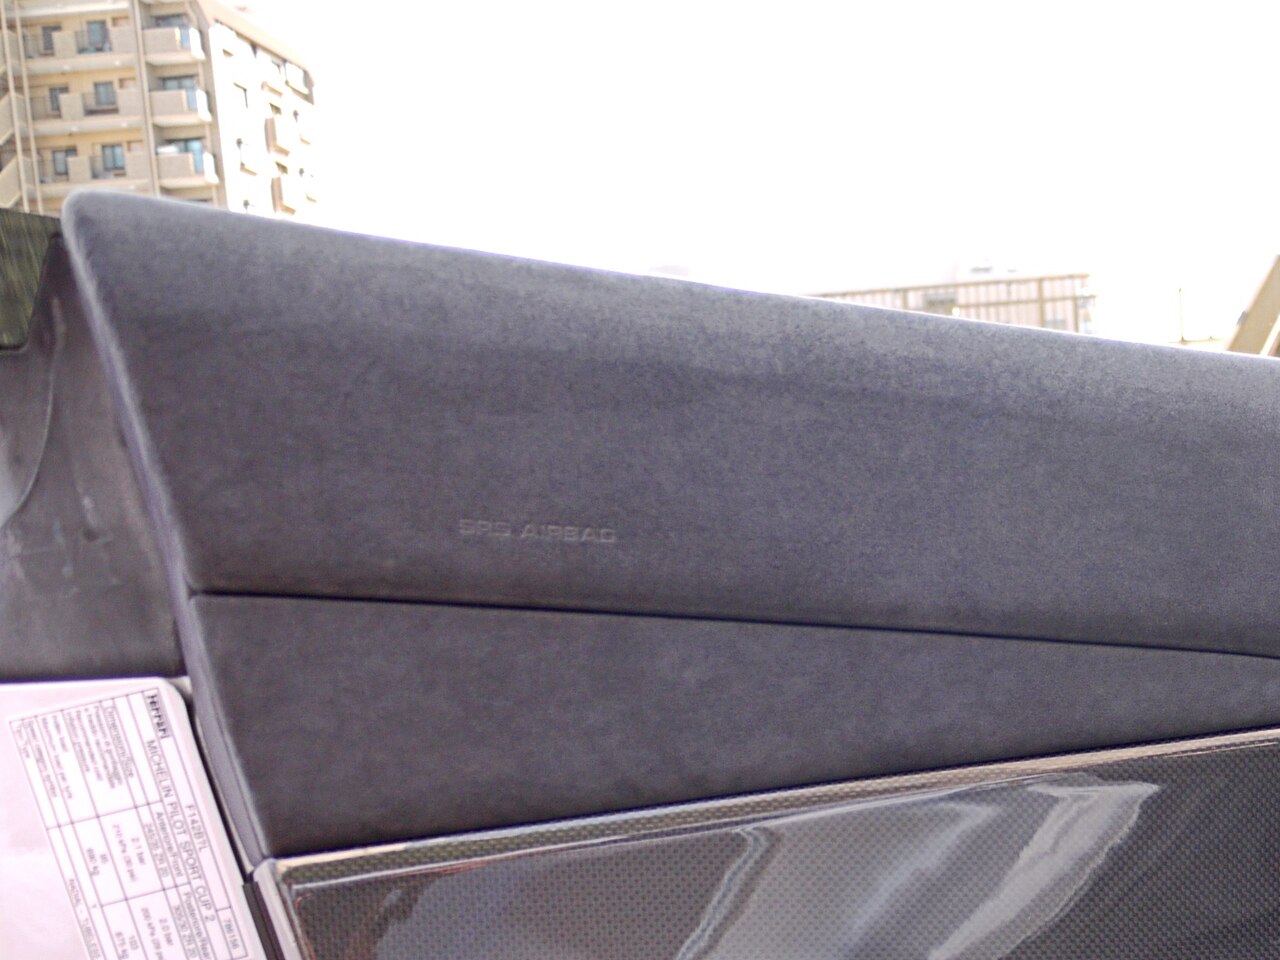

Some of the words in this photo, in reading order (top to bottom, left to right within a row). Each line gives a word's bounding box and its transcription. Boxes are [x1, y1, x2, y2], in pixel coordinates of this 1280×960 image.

[144, 739, 174, 798] MICHELIN
[165, 801, 187, 836] PILOT
[178, 840, 202, 881] SPORT
[194, 885, 212, 911] CUP
